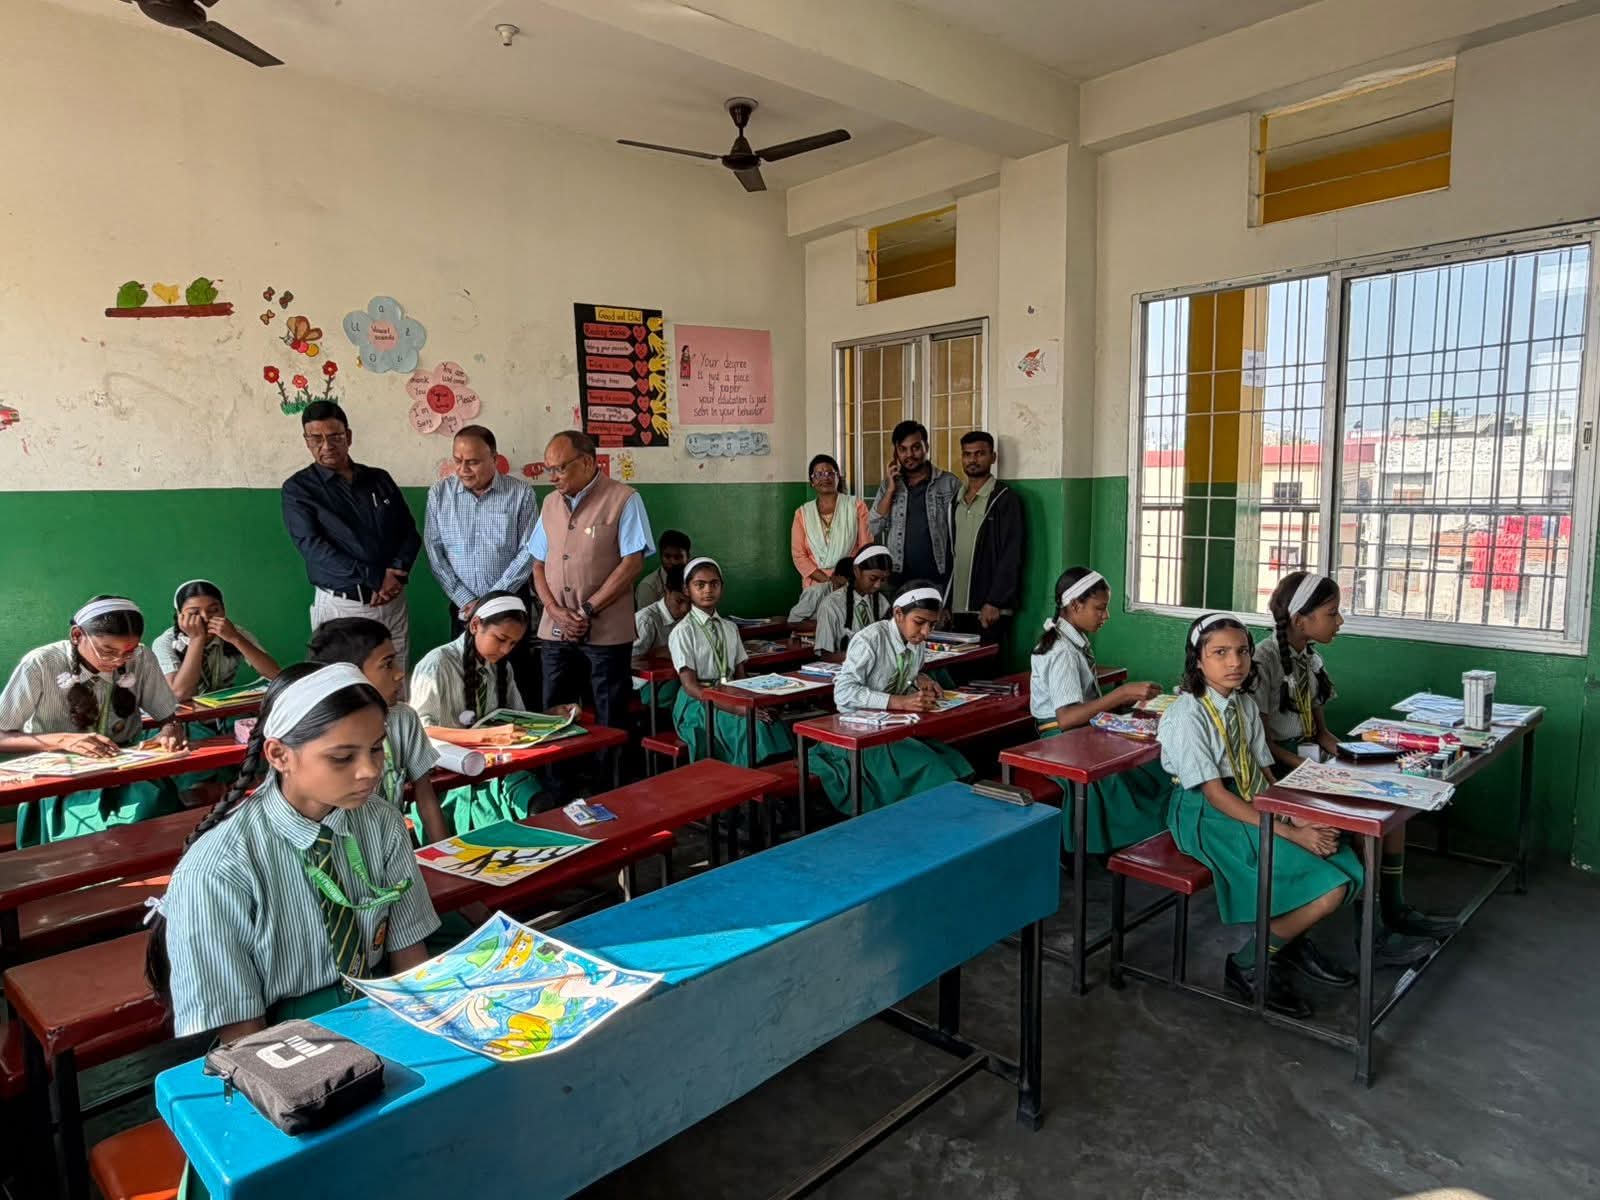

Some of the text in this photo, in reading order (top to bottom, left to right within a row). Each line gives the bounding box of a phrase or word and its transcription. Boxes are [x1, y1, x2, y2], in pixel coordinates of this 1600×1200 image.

[700, 352, 748, 373] Your degree
[720, 384, 742, 397] paper
[719, 408, 735, 420] your
